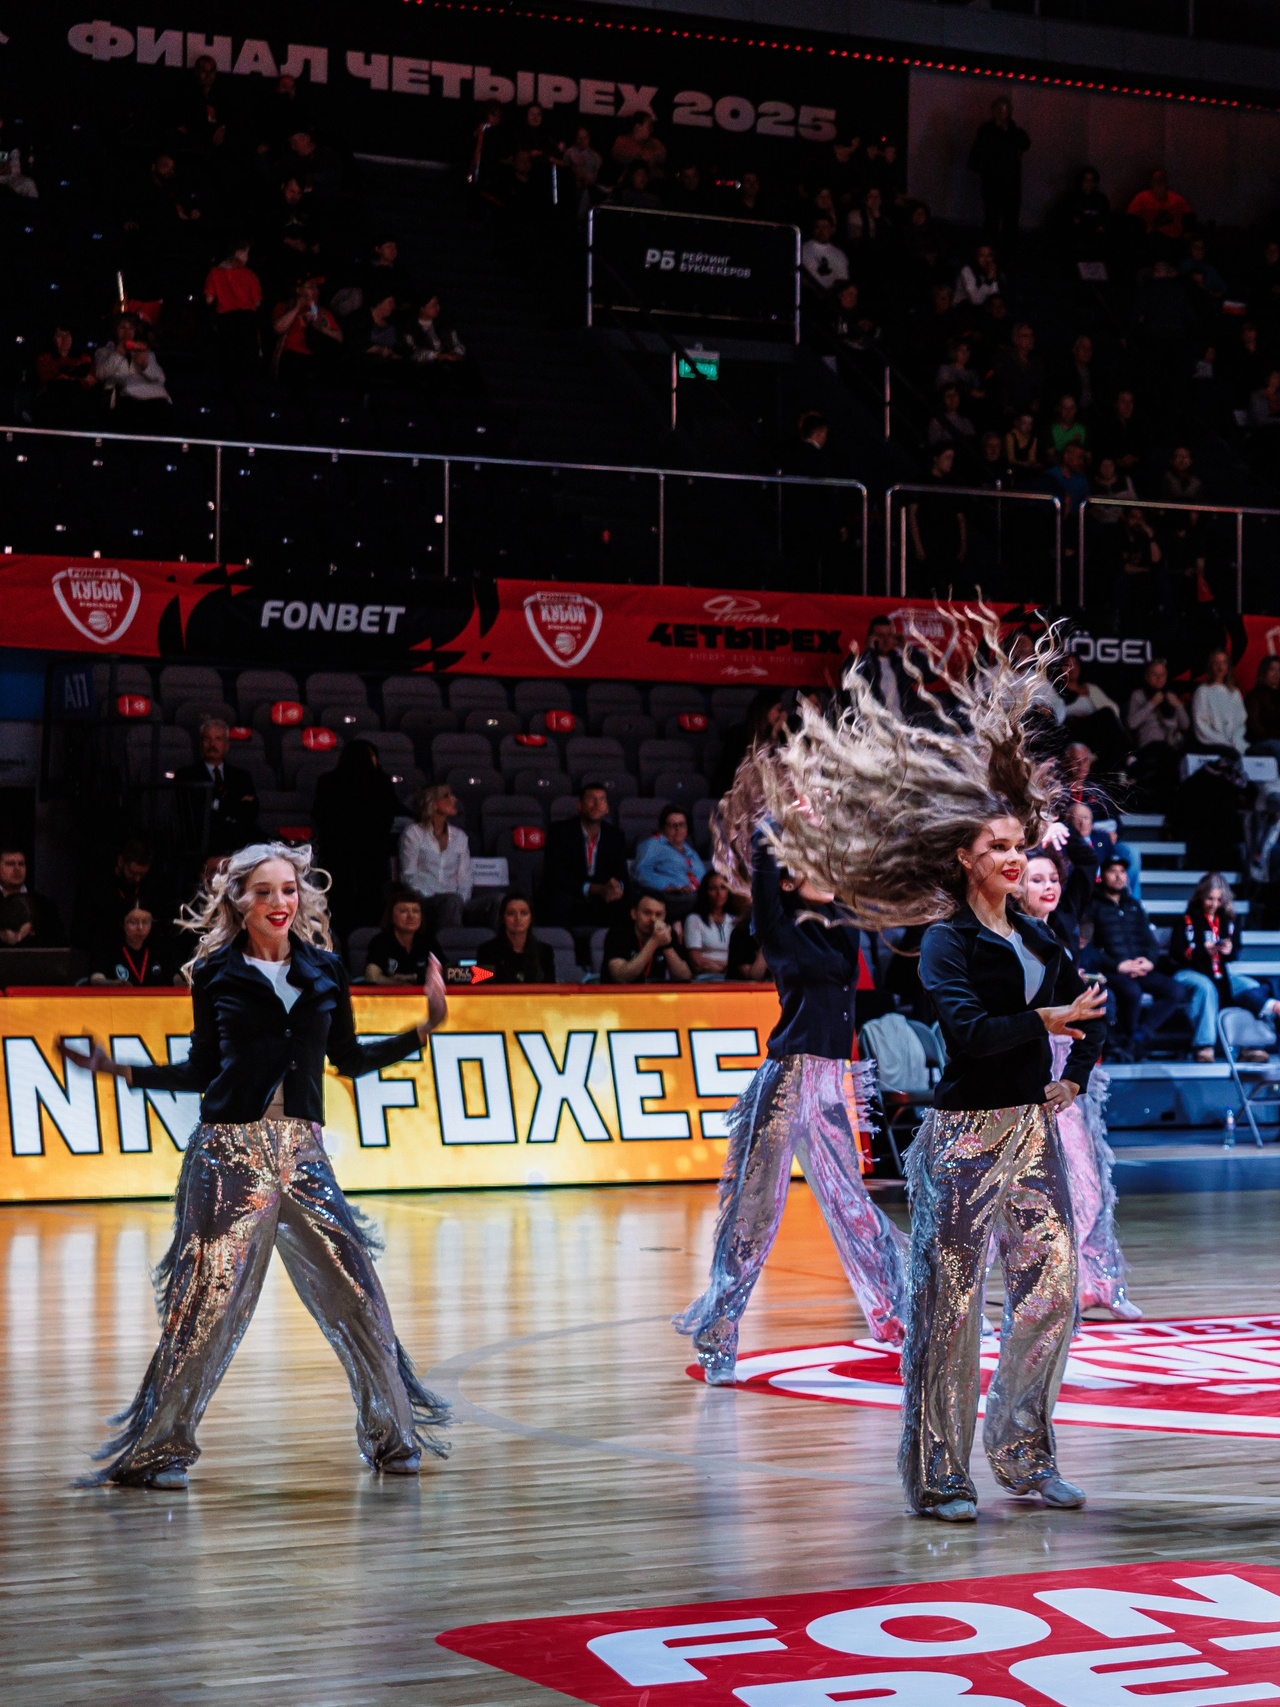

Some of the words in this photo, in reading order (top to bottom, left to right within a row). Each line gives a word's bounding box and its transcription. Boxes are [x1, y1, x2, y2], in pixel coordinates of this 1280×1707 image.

[67, 19, 329, 85] ФИНАЛ
[345, 50, 659, 121] ЧЕТЫРЕХ
[672, 90, 838, 142] 2025
[643, 248, 677, 272] РБ
[679, 262, 752, 280] БУКМЕКЕРОВ
[69, 580, 124, 602] КУБОК
[260, 600, 406, 635] FONBET
[353, 1028, 762, 1148] FOXES
